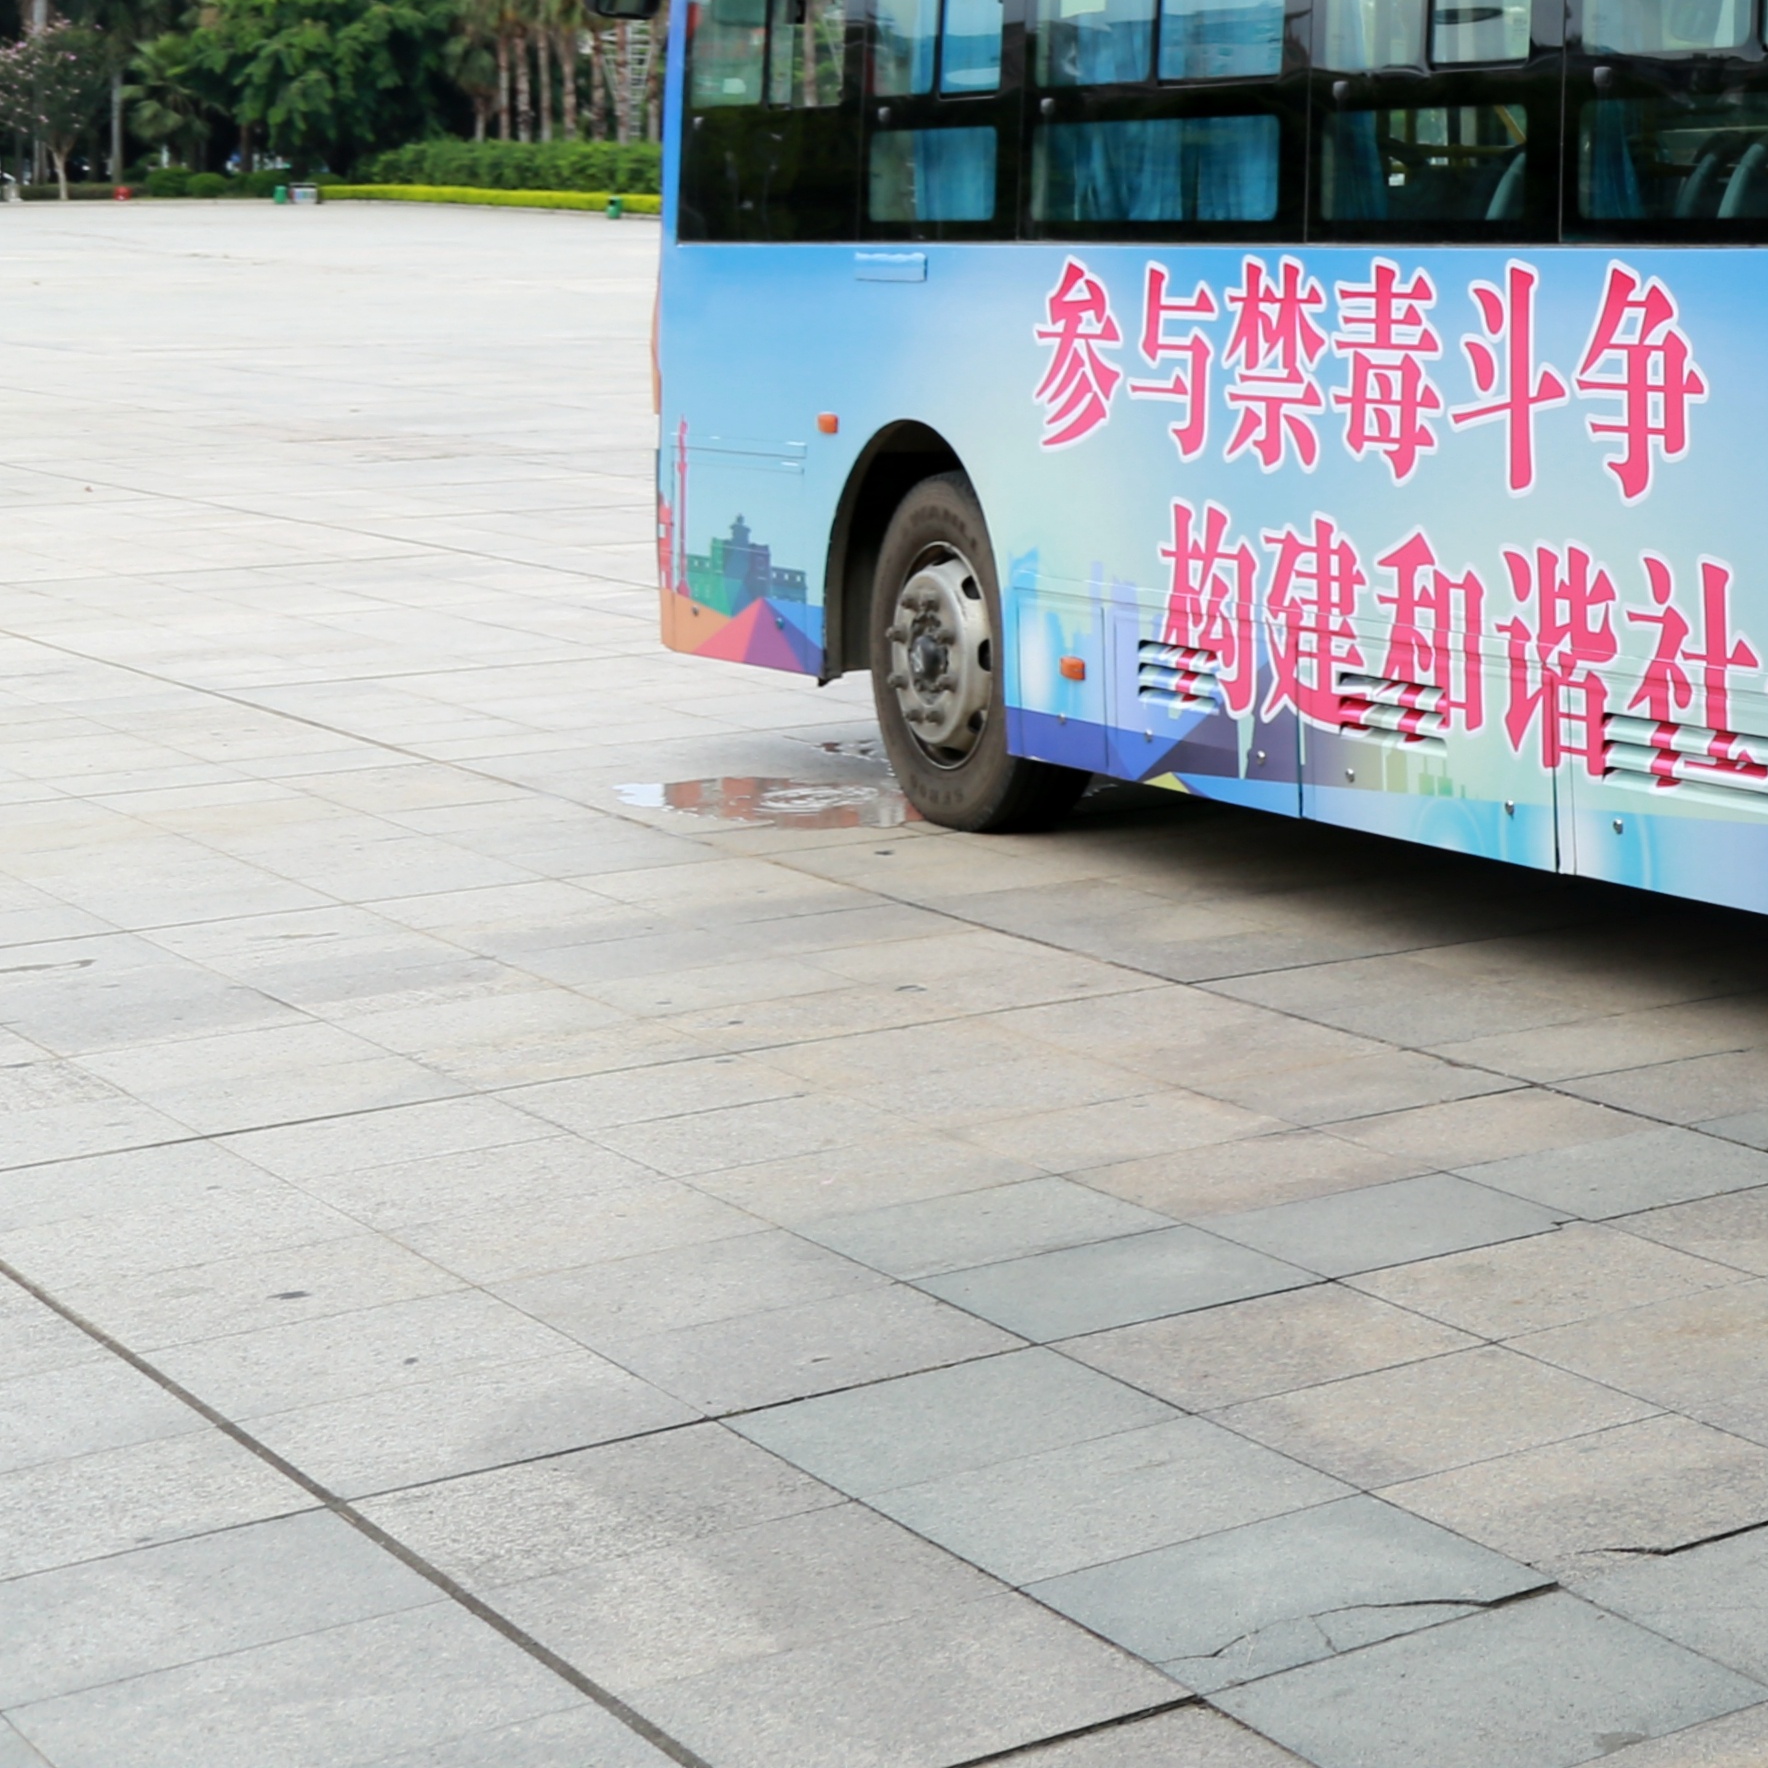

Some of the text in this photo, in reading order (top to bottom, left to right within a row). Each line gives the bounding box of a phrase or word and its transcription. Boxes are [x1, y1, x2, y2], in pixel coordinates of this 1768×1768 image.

[1034, 254, 1708, 500] 参与禁毒斗争
